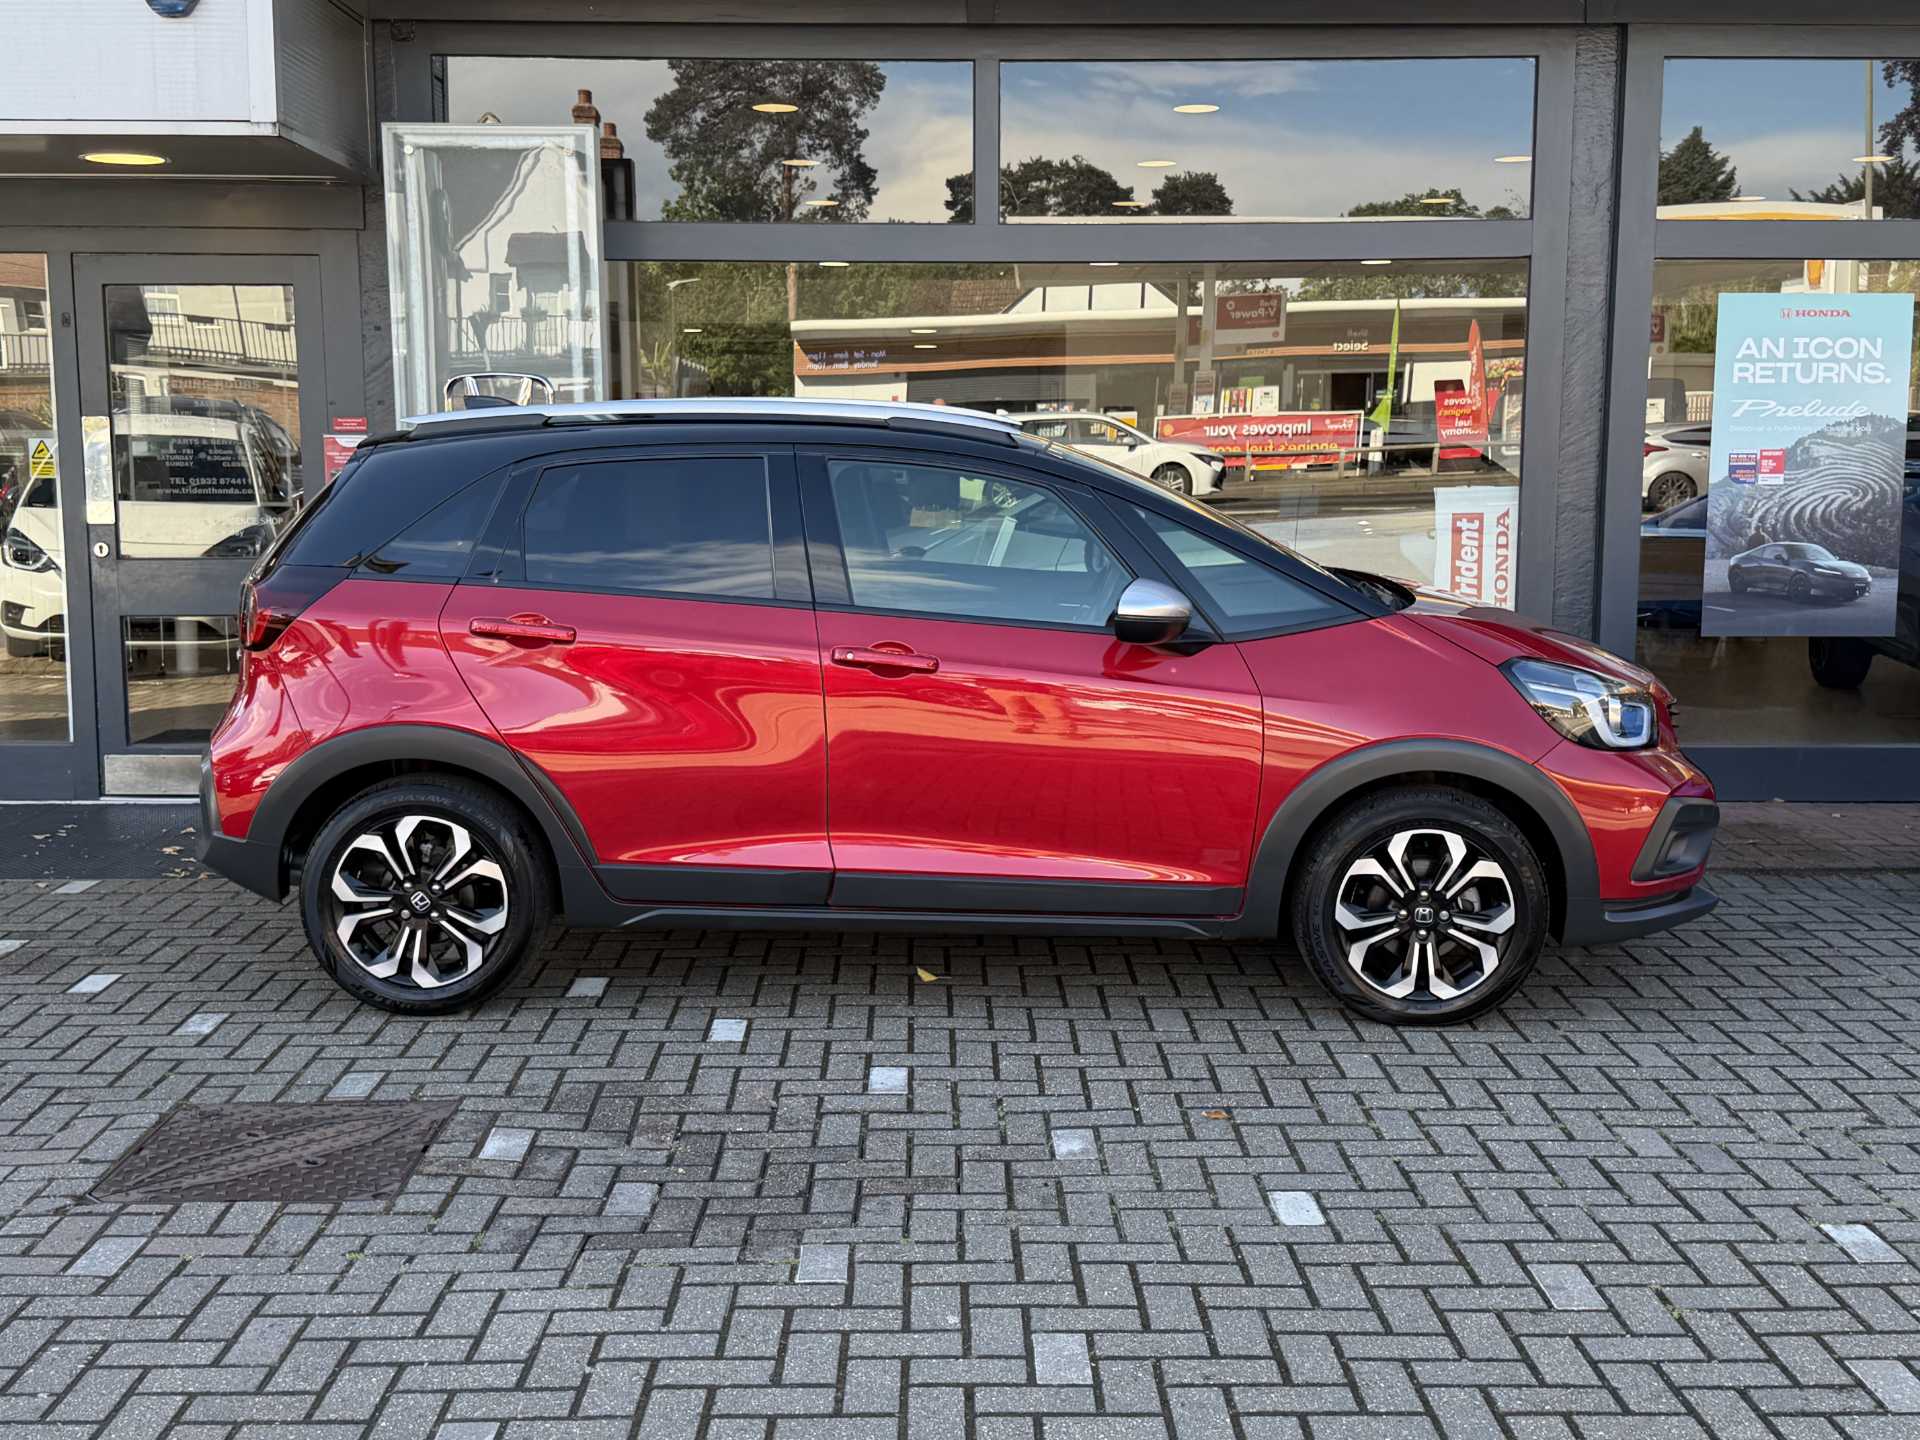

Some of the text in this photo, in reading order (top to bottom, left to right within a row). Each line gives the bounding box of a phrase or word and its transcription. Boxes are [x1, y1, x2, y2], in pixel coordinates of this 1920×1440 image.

[1795, 309, 1851, 318] HONDA
[1735, 336, 1883, 359] AN ICON
[1732, 362, 1892, 384] RETURNS.
[1730, 398, 1871, 418] Prelude
[170, 477, 187, 485] TEL
